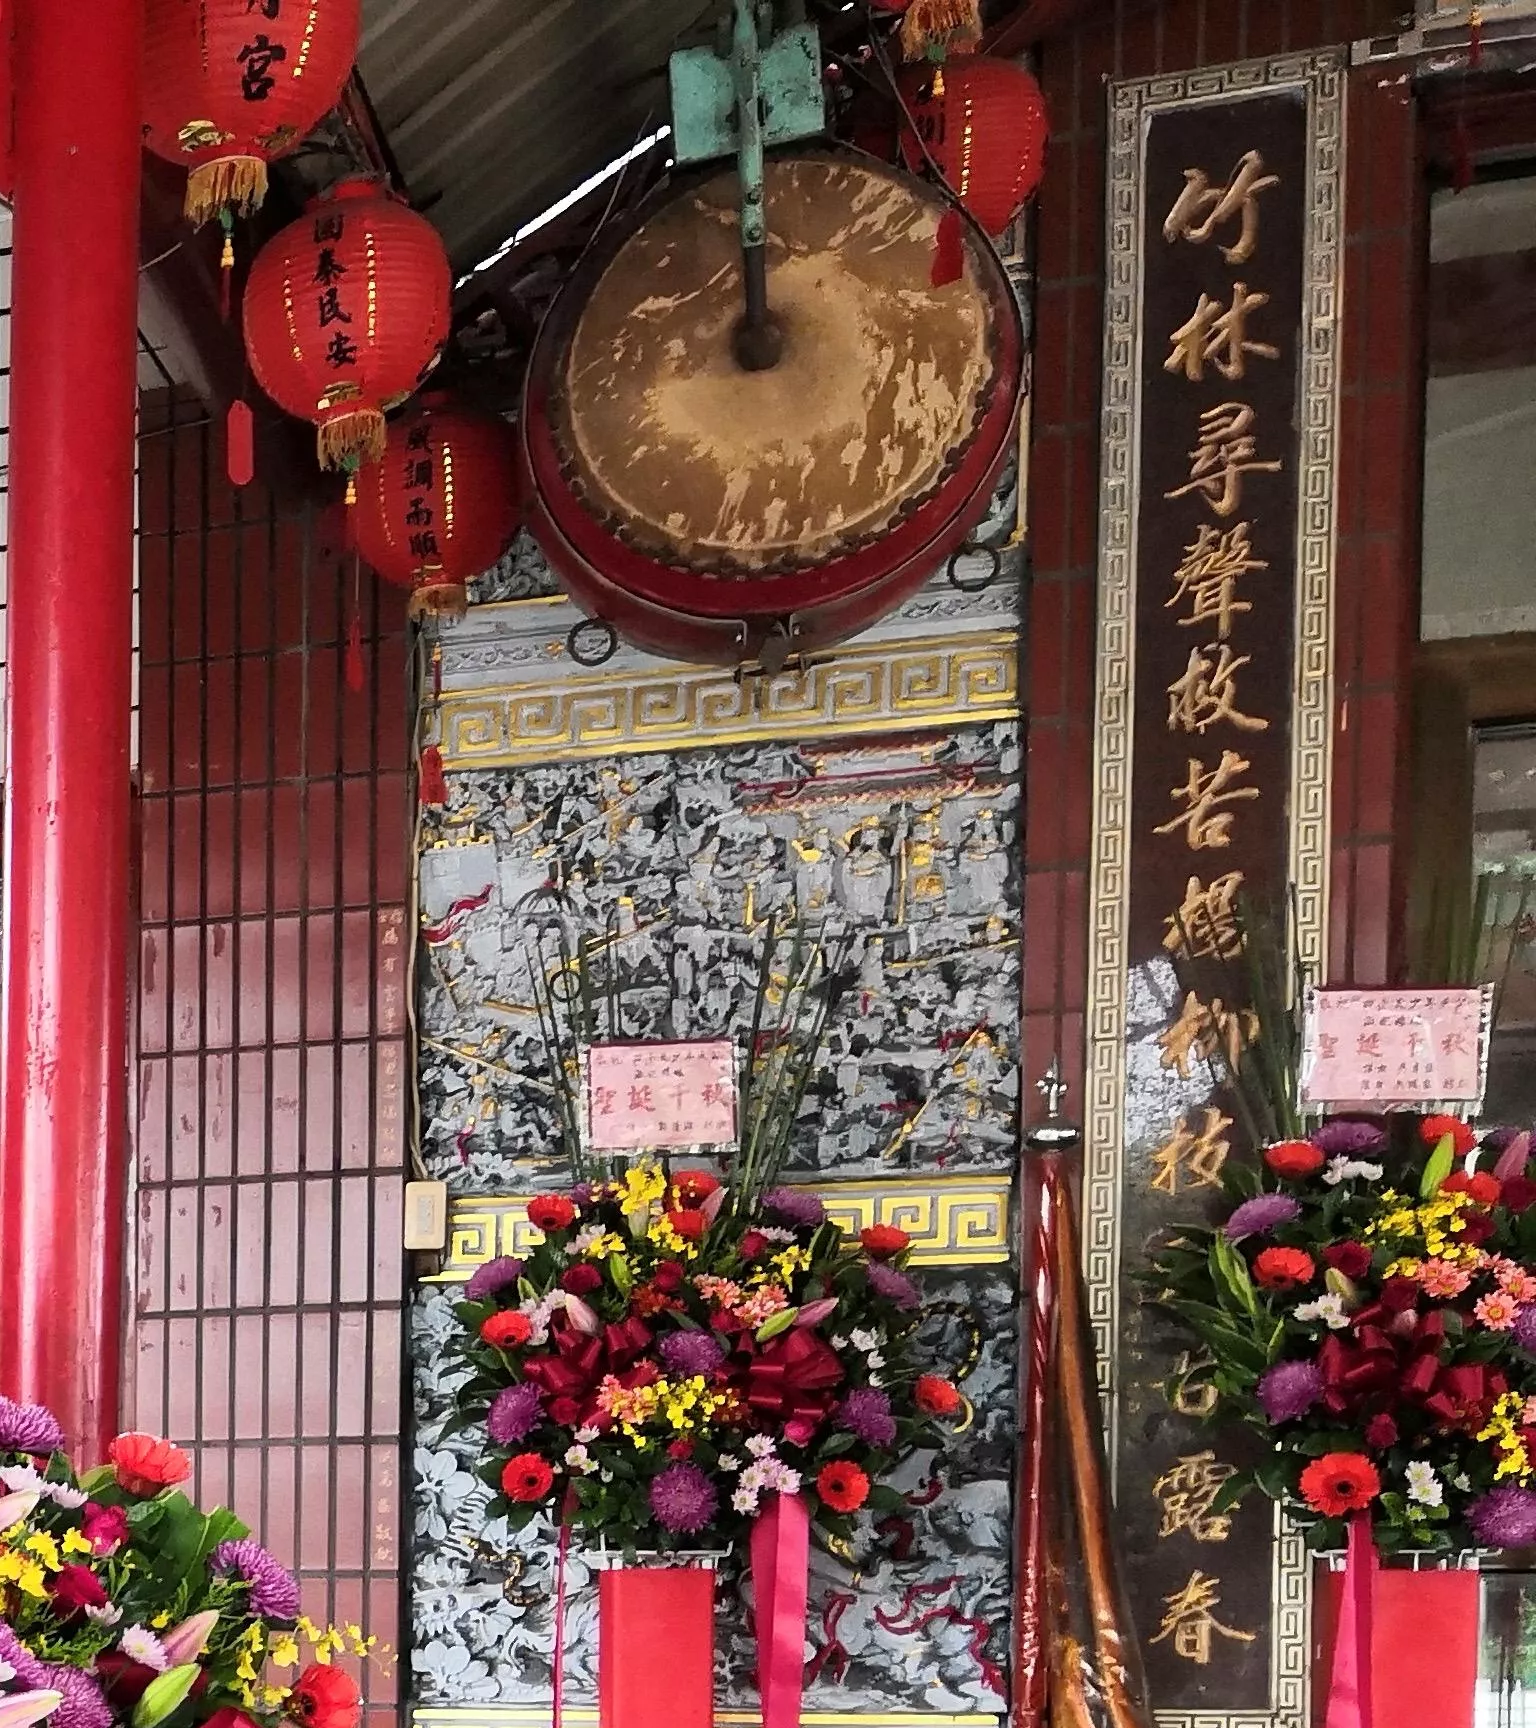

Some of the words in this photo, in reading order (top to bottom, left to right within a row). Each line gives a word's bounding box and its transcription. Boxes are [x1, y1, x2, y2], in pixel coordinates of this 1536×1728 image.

[236, 0, 286, 102] 宮
[313, 214, 357, 369] 國泰民安
